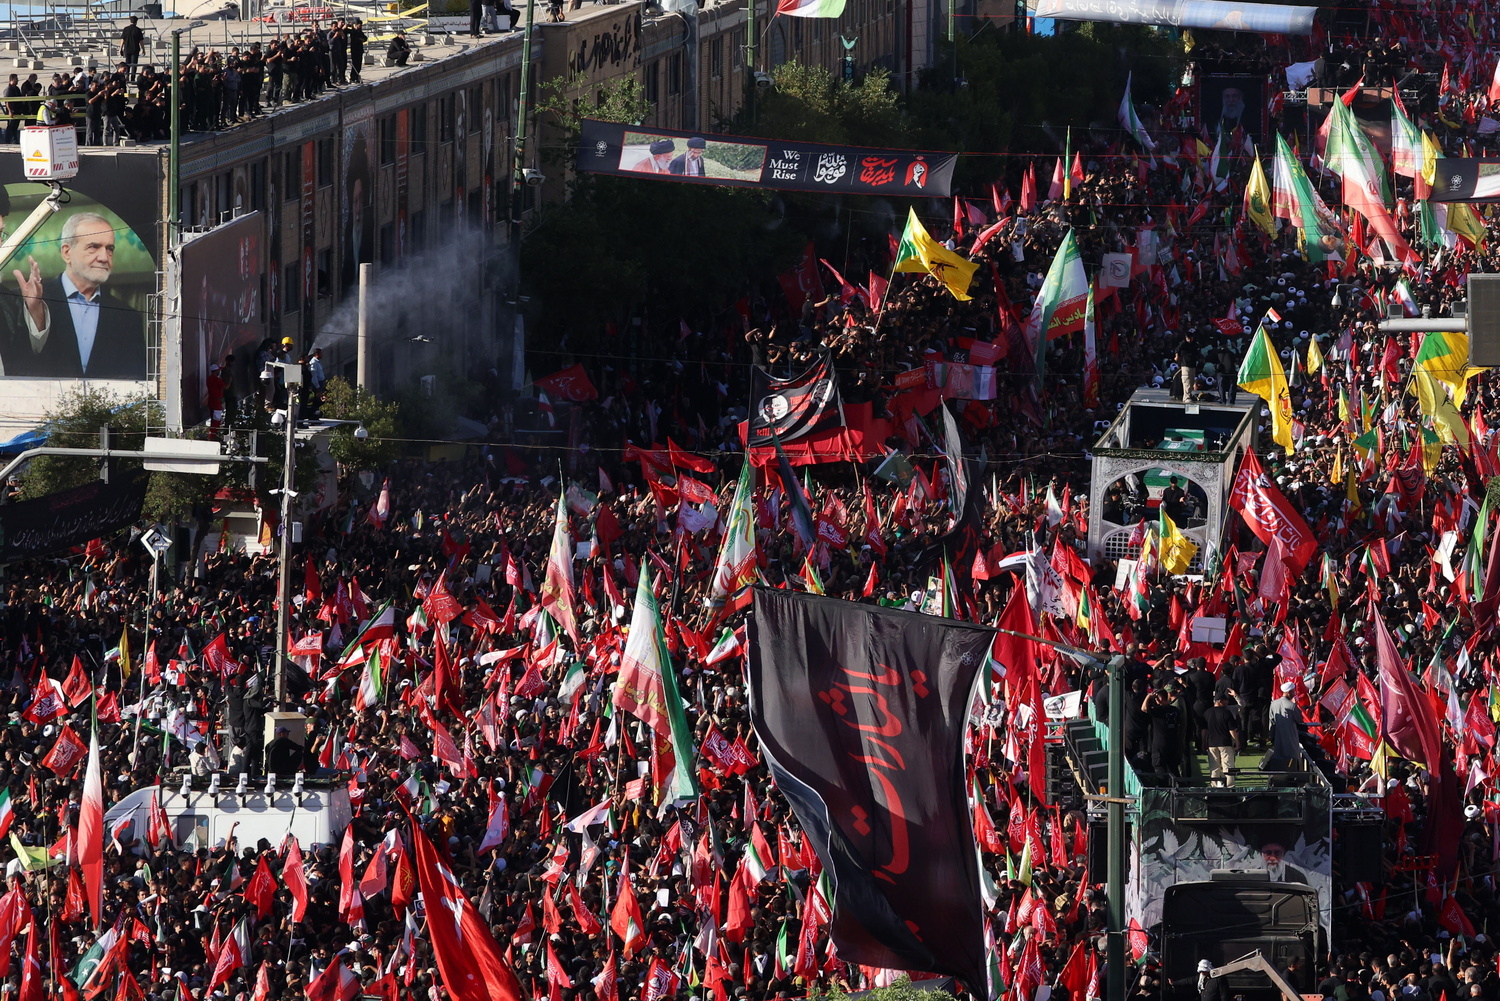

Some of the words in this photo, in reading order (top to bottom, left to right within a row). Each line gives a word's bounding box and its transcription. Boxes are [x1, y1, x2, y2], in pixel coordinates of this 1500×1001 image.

[783, 150, 800, 160] We
[769, 159, 798, 170] Must
[772, 169, 796, 180] Rise
